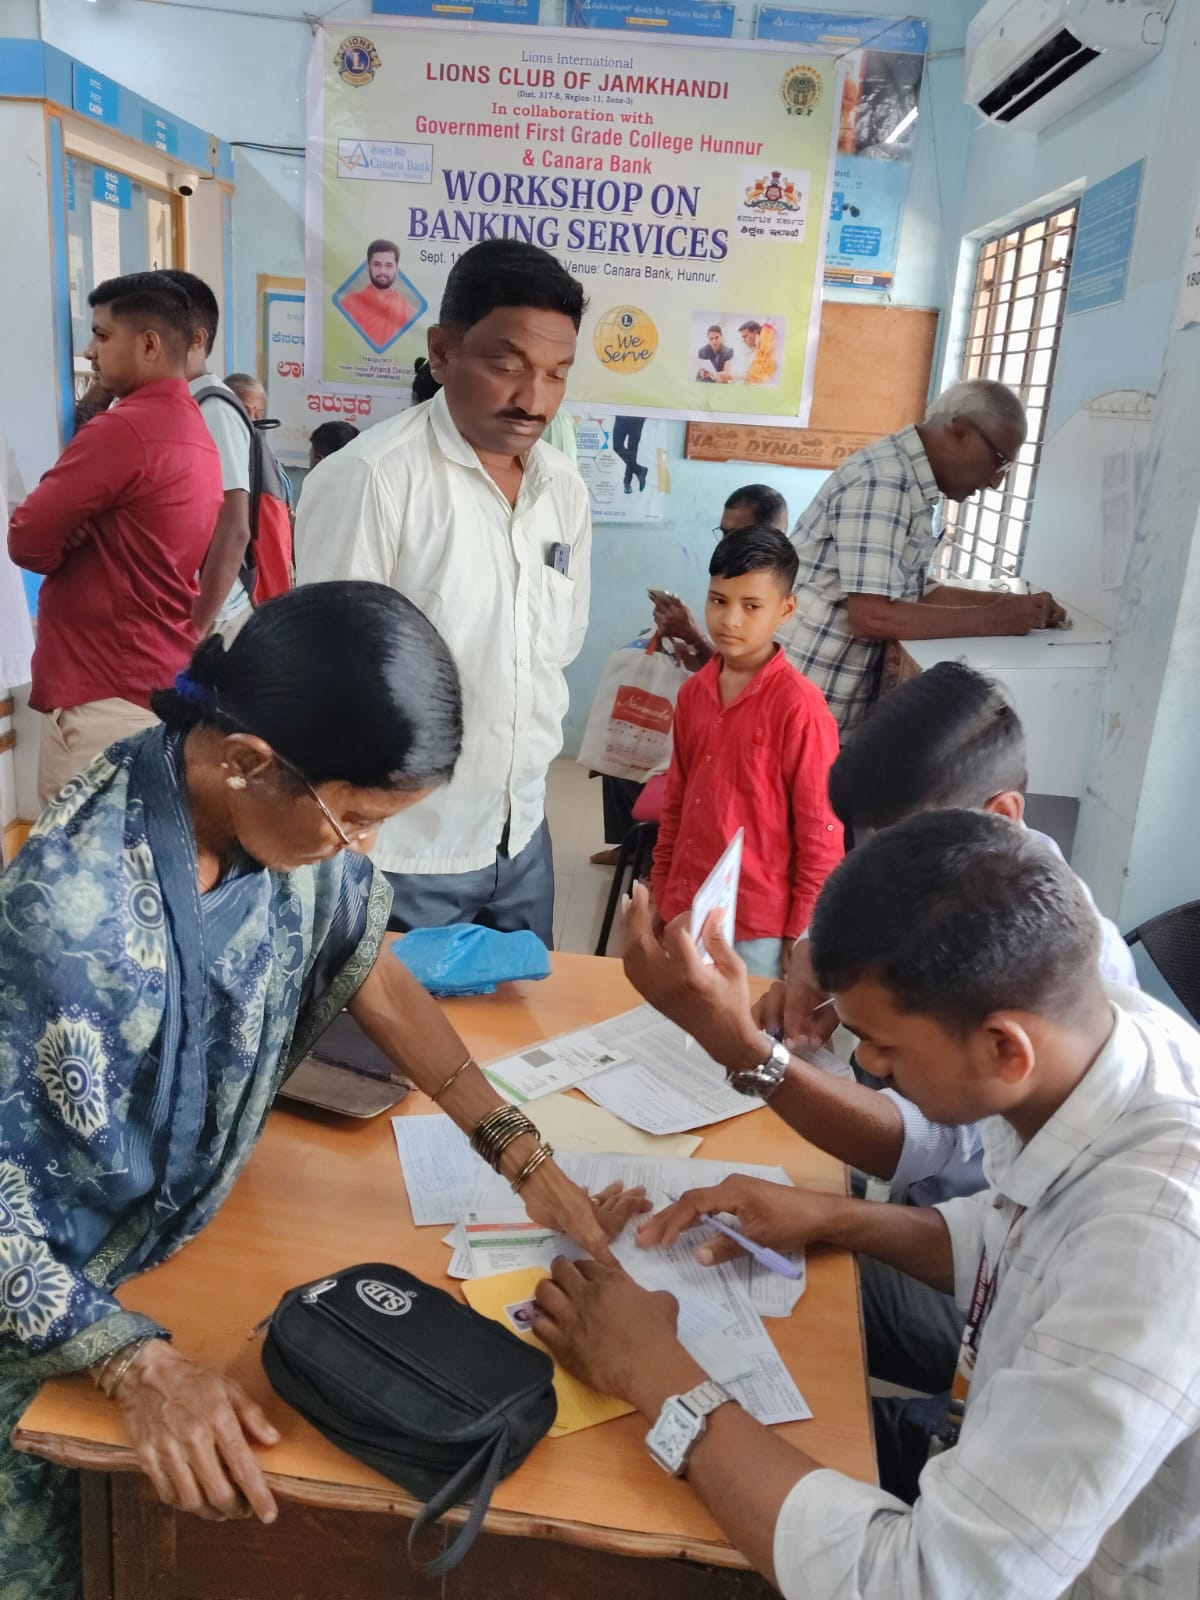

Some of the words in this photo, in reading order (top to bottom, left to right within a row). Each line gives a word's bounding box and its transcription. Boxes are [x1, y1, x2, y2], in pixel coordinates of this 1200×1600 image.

[521, 51, 553, 64] Lions
[556, 52, 633, 69] International
[426, 62, 490, 84] LIONS
[499, 67, 555, 88] CLUB
[563, 70, 592, 90] OF
[598, 73, 729, 100] JAMKHANDI
[492, 102, 507, 115] In
[512, 105, 614, 122] collaboration
[620, 111, 654, 125] with
[415, 115, 520, 140] Government
[526, 122, 565, 143] First
[571, 125, 622, 147] Grade
[629, 129, 693, 154] College
[700, 134, 764, 156] Hunnur
[370, 157, 404, 171] Canara
[406, 159, 431, 172] Bank
[522, 149, 536, 168] &
[542, 149, 603, 171] Canara
[609, 154, 652, 175] Bank
[441, 168, 643, 214] WORKSHOP
[651, 183, 701, 218] ON
[407, 206, 560, 249] BANKING
[567, 218, 729, 261] SERVICES
[420, 250, 446, 266] Sept.
[564, 260, 600, 275] Venue:
[603, 263, 641, 278] Canara
[644, 266, 673, 282] Bank,
[677, 269, 719, 284] Hunnur.
[617, 333, 645, 349] We
[601, 345, 654, 364] Serve
[369, 365, 391, 374] Anand
[306, 394, 373, 422] ಇರುತ್ತದೆ
[746, 439, 800, 458] DYNA
[363, 1283, 406, 1311] SJB
